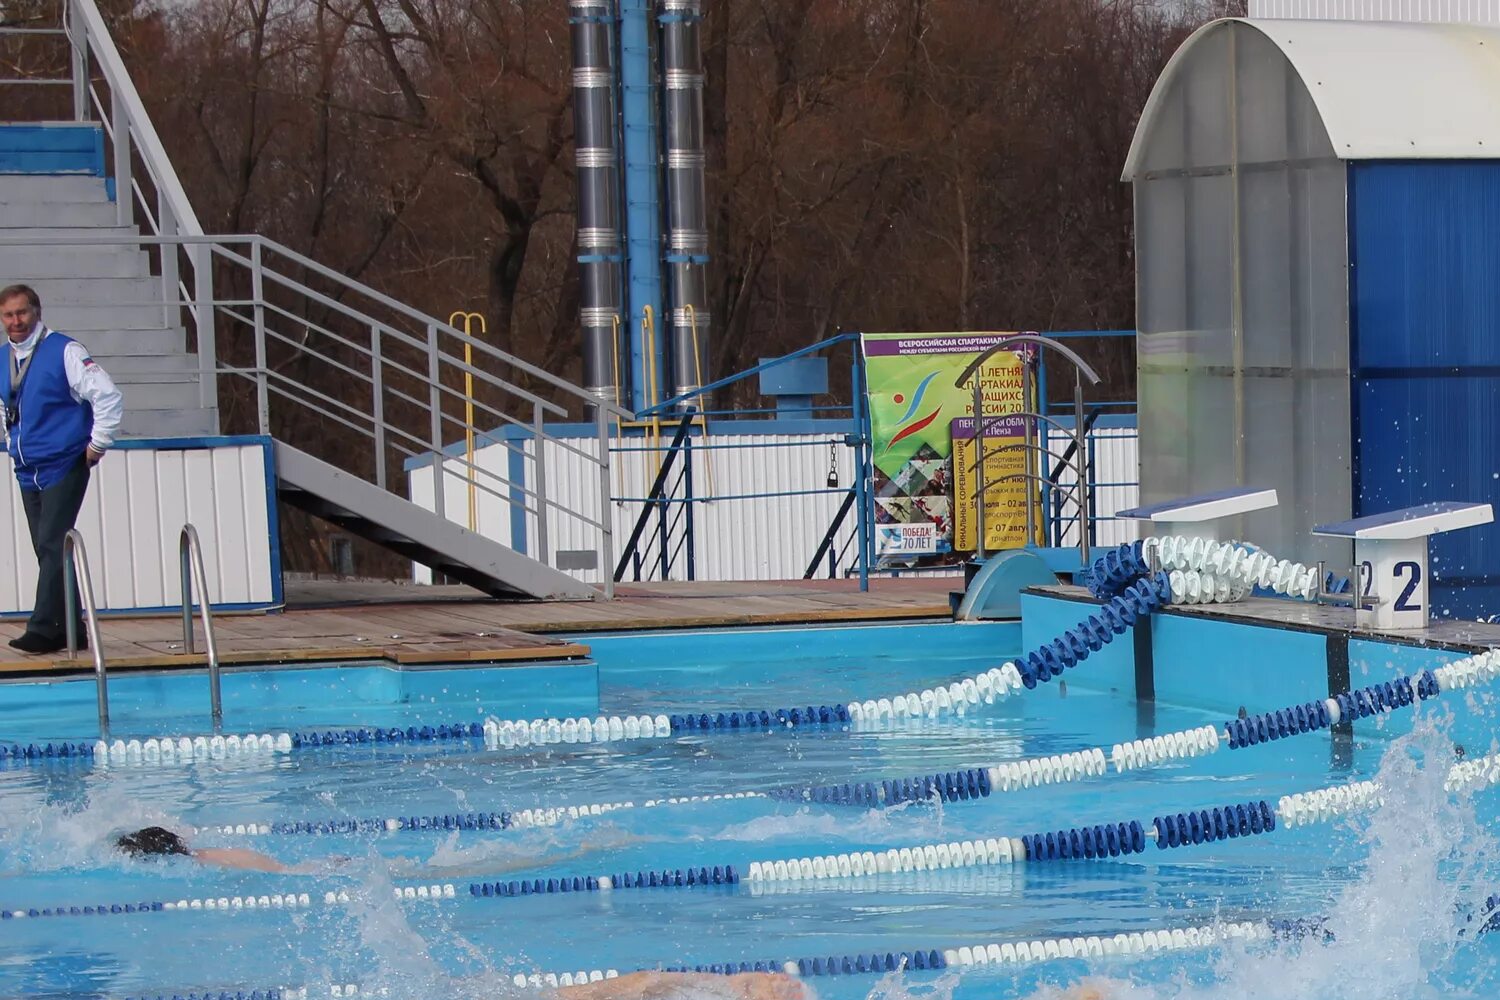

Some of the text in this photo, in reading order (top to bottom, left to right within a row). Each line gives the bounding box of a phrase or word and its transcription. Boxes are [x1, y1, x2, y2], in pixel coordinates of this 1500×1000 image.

[898, 339, 957, 347] ВСЕРОССИЙСКАЯ
[957, 440, 967, 549] ФИНАЛЬНЫЕ СОРЕВНОВАНИЯ
[902, 527, 932, 536] ПОБЕДА!
[903, 537, 931, 549] 70 ЛЕТ
[1393, 561, 1421, 611] 2
